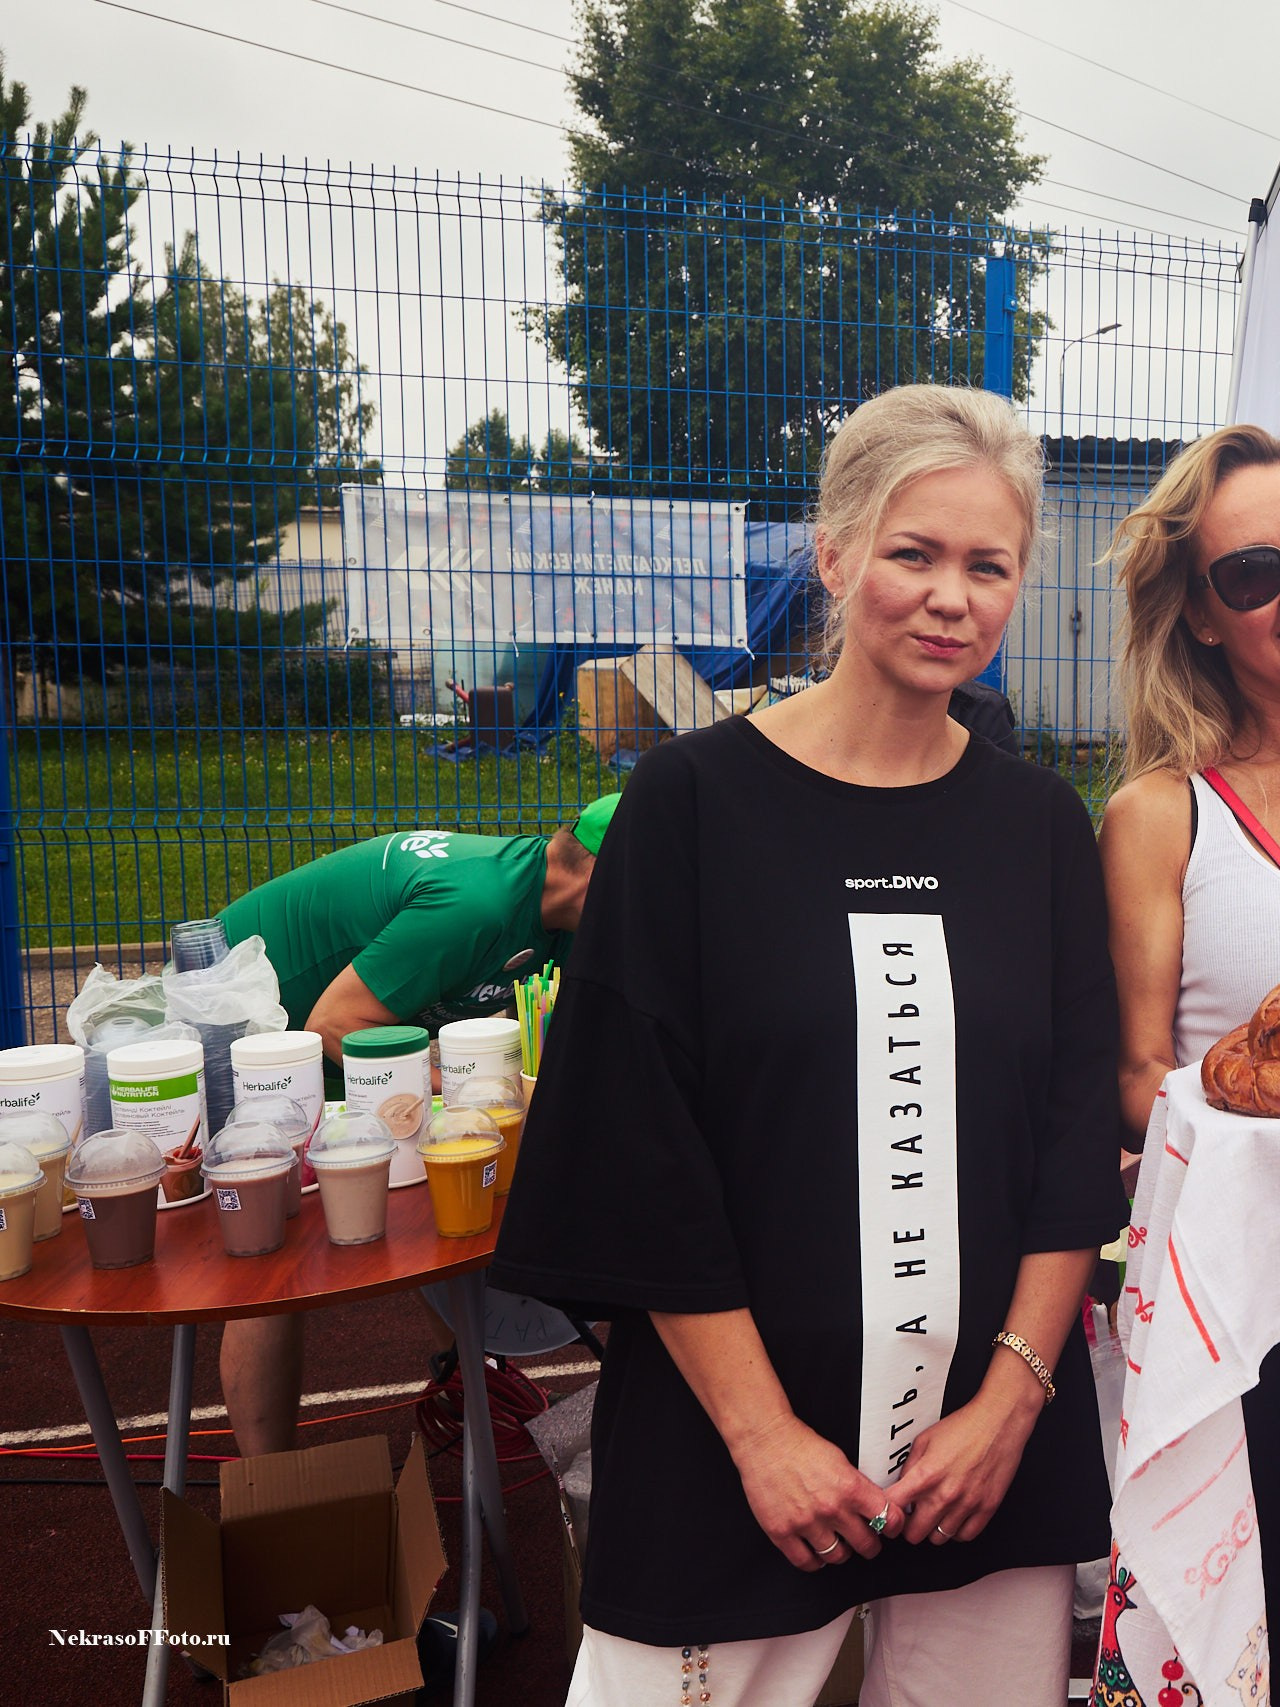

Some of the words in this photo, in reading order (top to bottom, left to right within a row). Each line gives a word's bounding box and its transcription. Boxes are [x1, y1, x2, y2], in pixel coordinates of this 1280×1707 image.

[844, 875, 939, 890] sport.DIVO
[882, 943, 923, 1190] КАЗАТЬСЯ
[242, 1081, 288, 1091] Herbalife
[347, 1074, 388, 1086] Herbalife
[0, 1097, 36, 1108] rbalife
[893, 1226, 926, 1279] НЕ
[896, 1314, 927, 1335] А
[888, 1366, 924, 1475] ЫТЬ,
